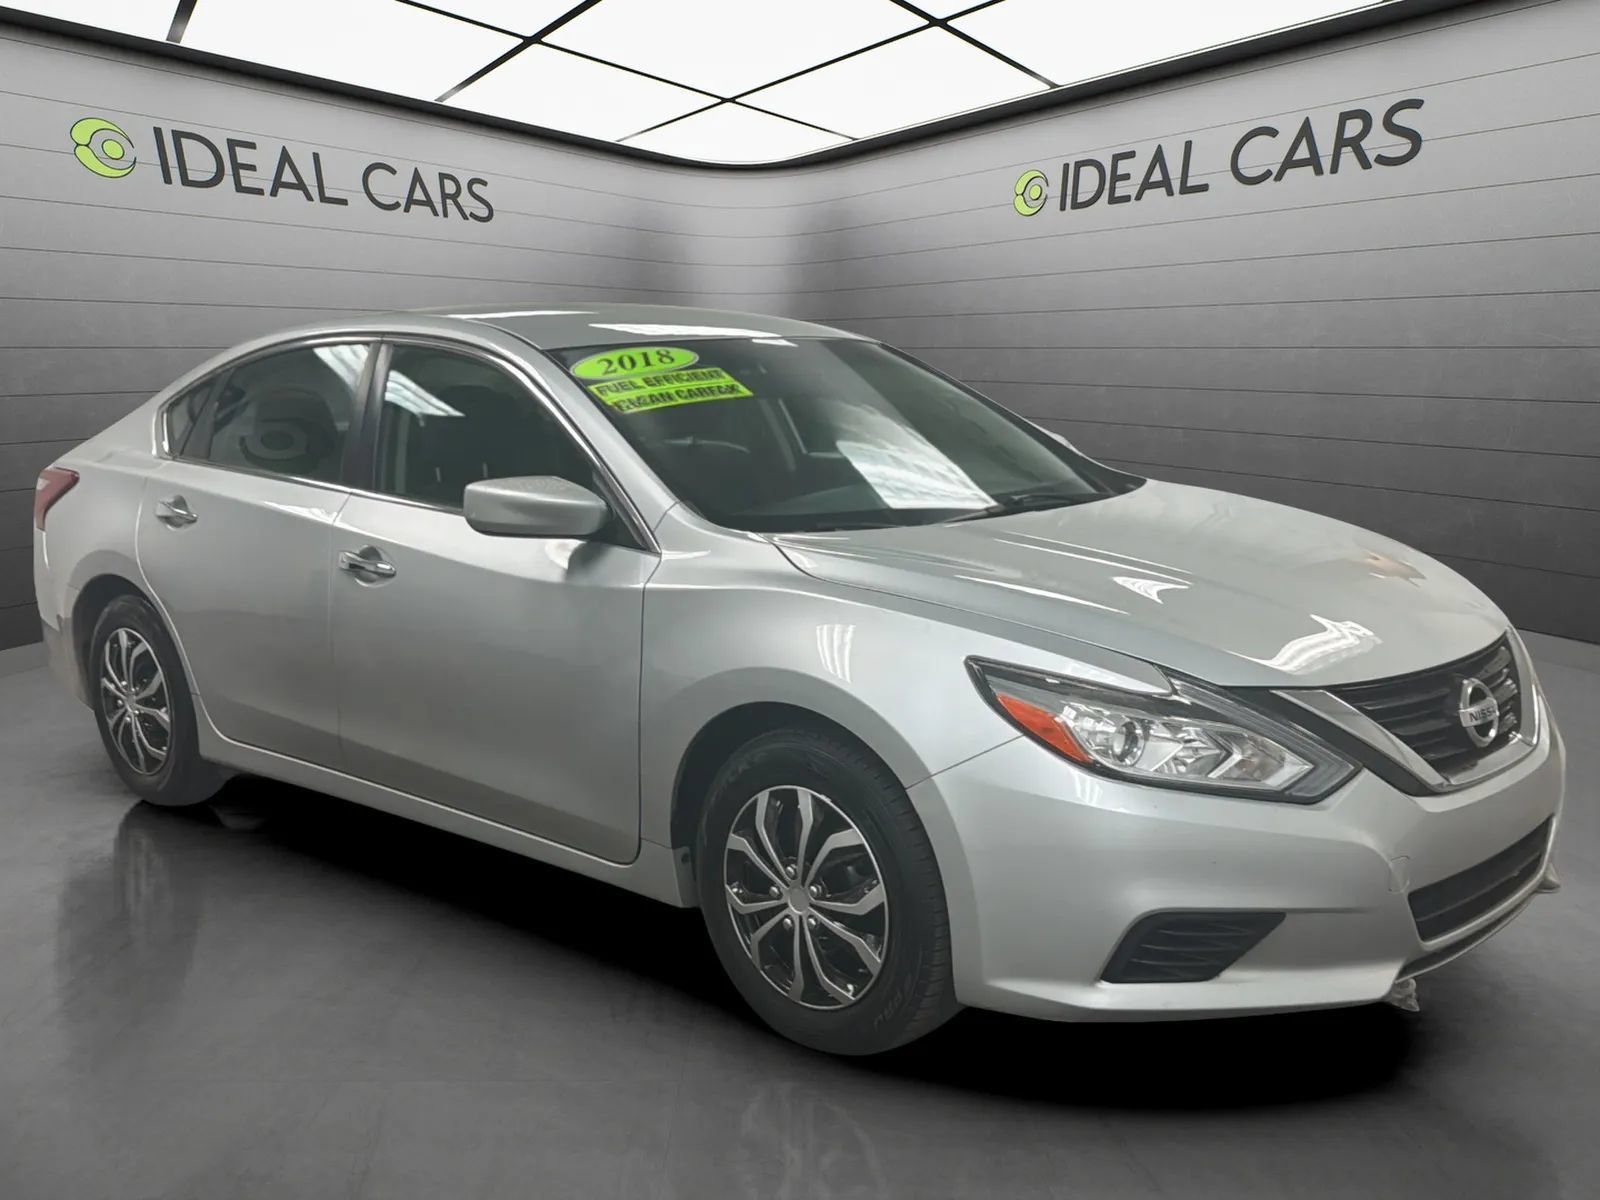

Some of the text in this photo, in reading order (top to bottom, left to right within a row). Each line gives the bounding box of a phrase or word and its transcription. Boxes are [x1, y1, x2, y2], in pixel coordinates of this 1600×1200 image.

[153, 126, 495, 223] IDEAL CARS
[1059, 98, 1425, 212] IDEAL CARS
[596, 349, 676, 376] 2018
[596, 368, 726, 397] FUEL EFFICIENT
